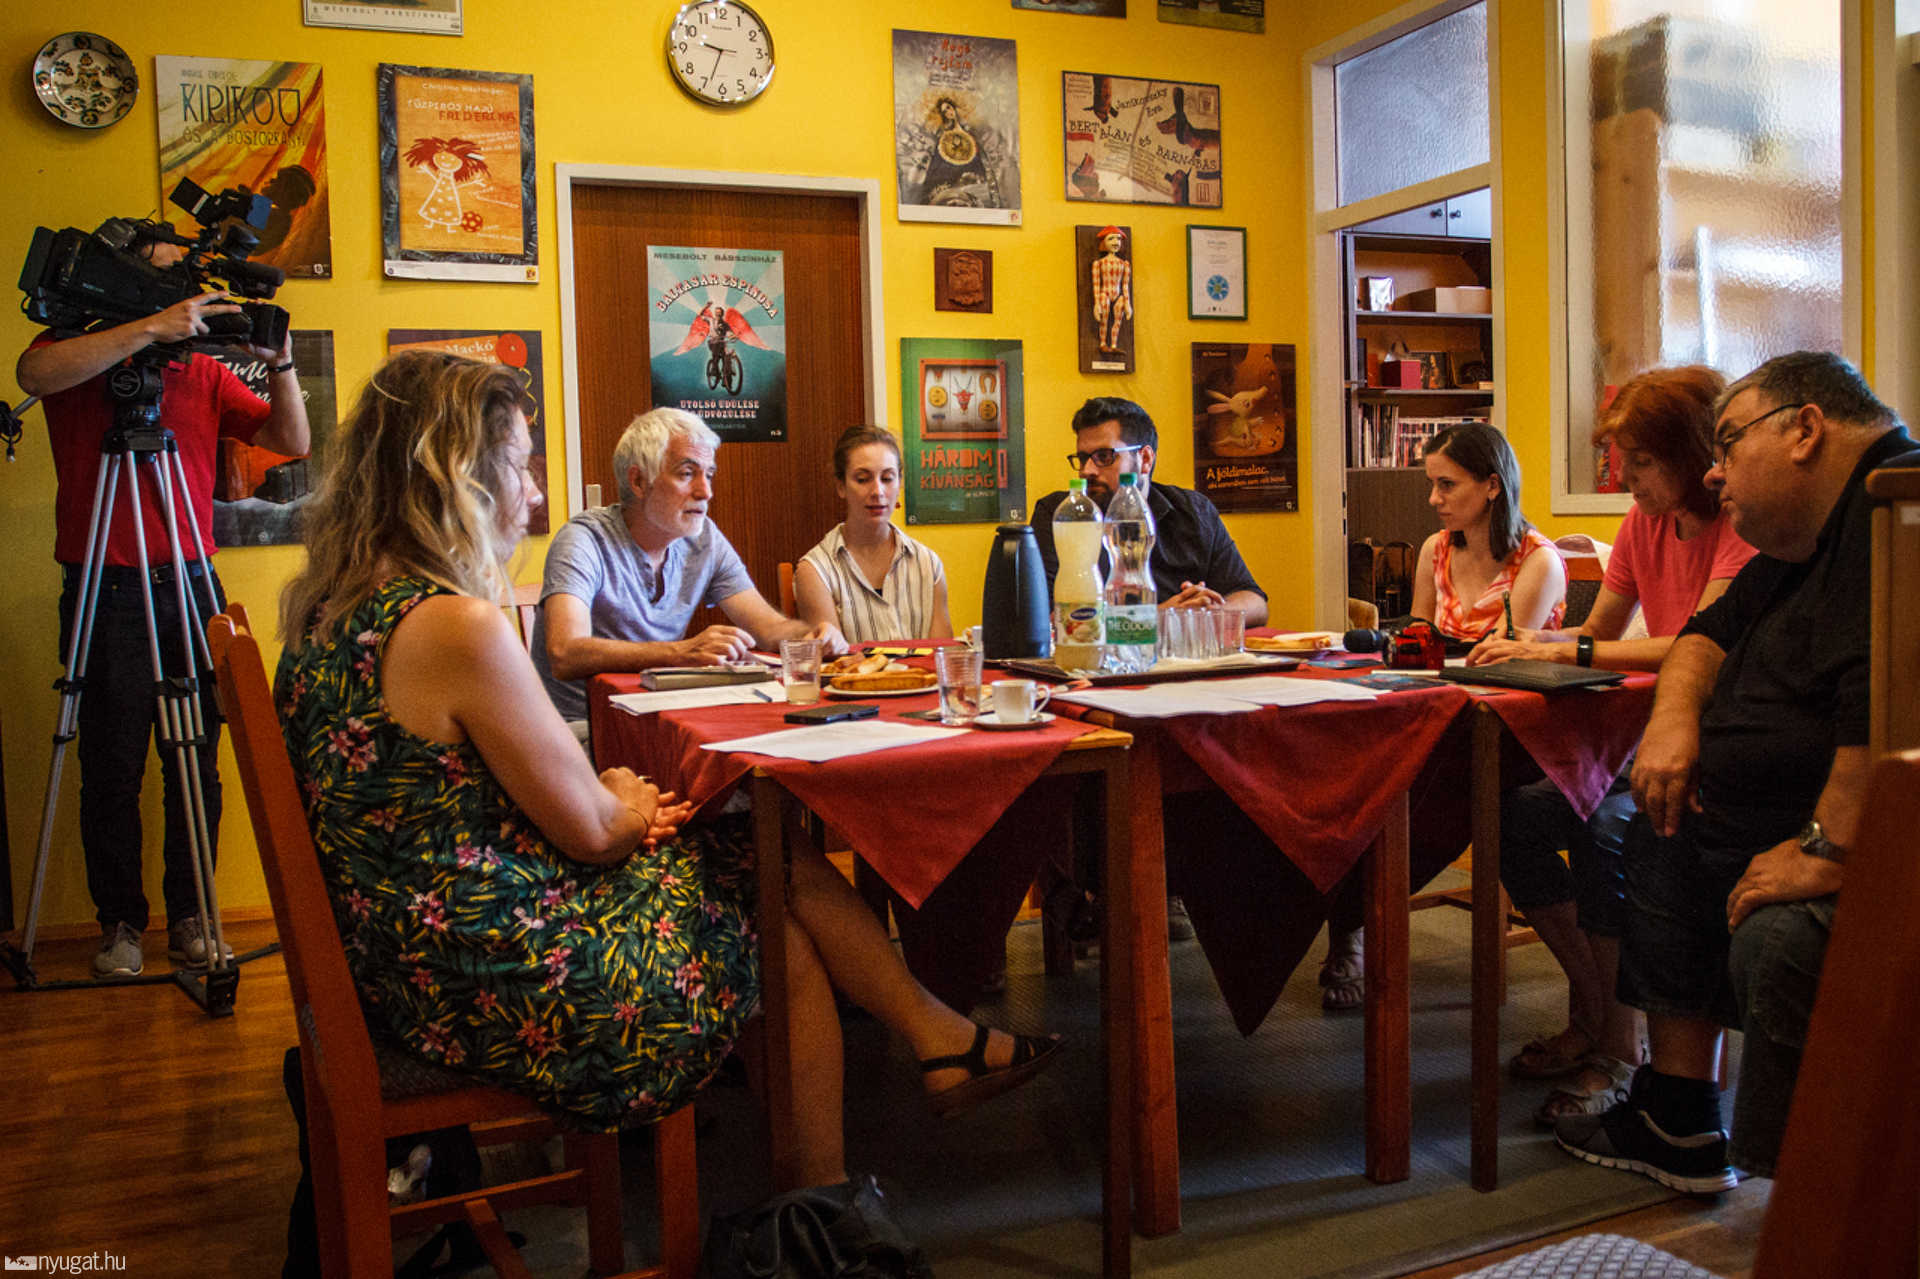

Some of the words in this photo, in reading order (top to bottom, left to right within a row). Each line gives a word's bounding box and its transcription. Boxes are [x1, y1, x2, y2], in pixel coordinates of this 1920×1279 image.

[698, 12, 709, 24] 11
[714, 8, 728, 20] 12
[736, 16, 741, 28] 1
[684, 24, 697, 38] 10
[748, 30, 757, 42] 2
[679, 42, 688, 54] 9
[756, 48, 764, 59] 3
[686, 62, 694, 74] 8
[750, 67, 758, 80] 4
[700, 76, 708, 88] 7
[736, 80, 744, 91] 5
[718, 83, 727, 95] 6
[179, 83, 301, 127] KIRIKOU
[1069, 120, 1132, 143] BERTALAN
[653, 252, 707, 261] MESEBOLT
[655, 272, 719, 313] BALTASAR
[721, 274, 779, 320] ESPINOSA
[921, 444, 994, 470] HÁROM
[1206, 467, 1216, 480] A
[920, 471, 995, 489] KÍVÁNSÁG
